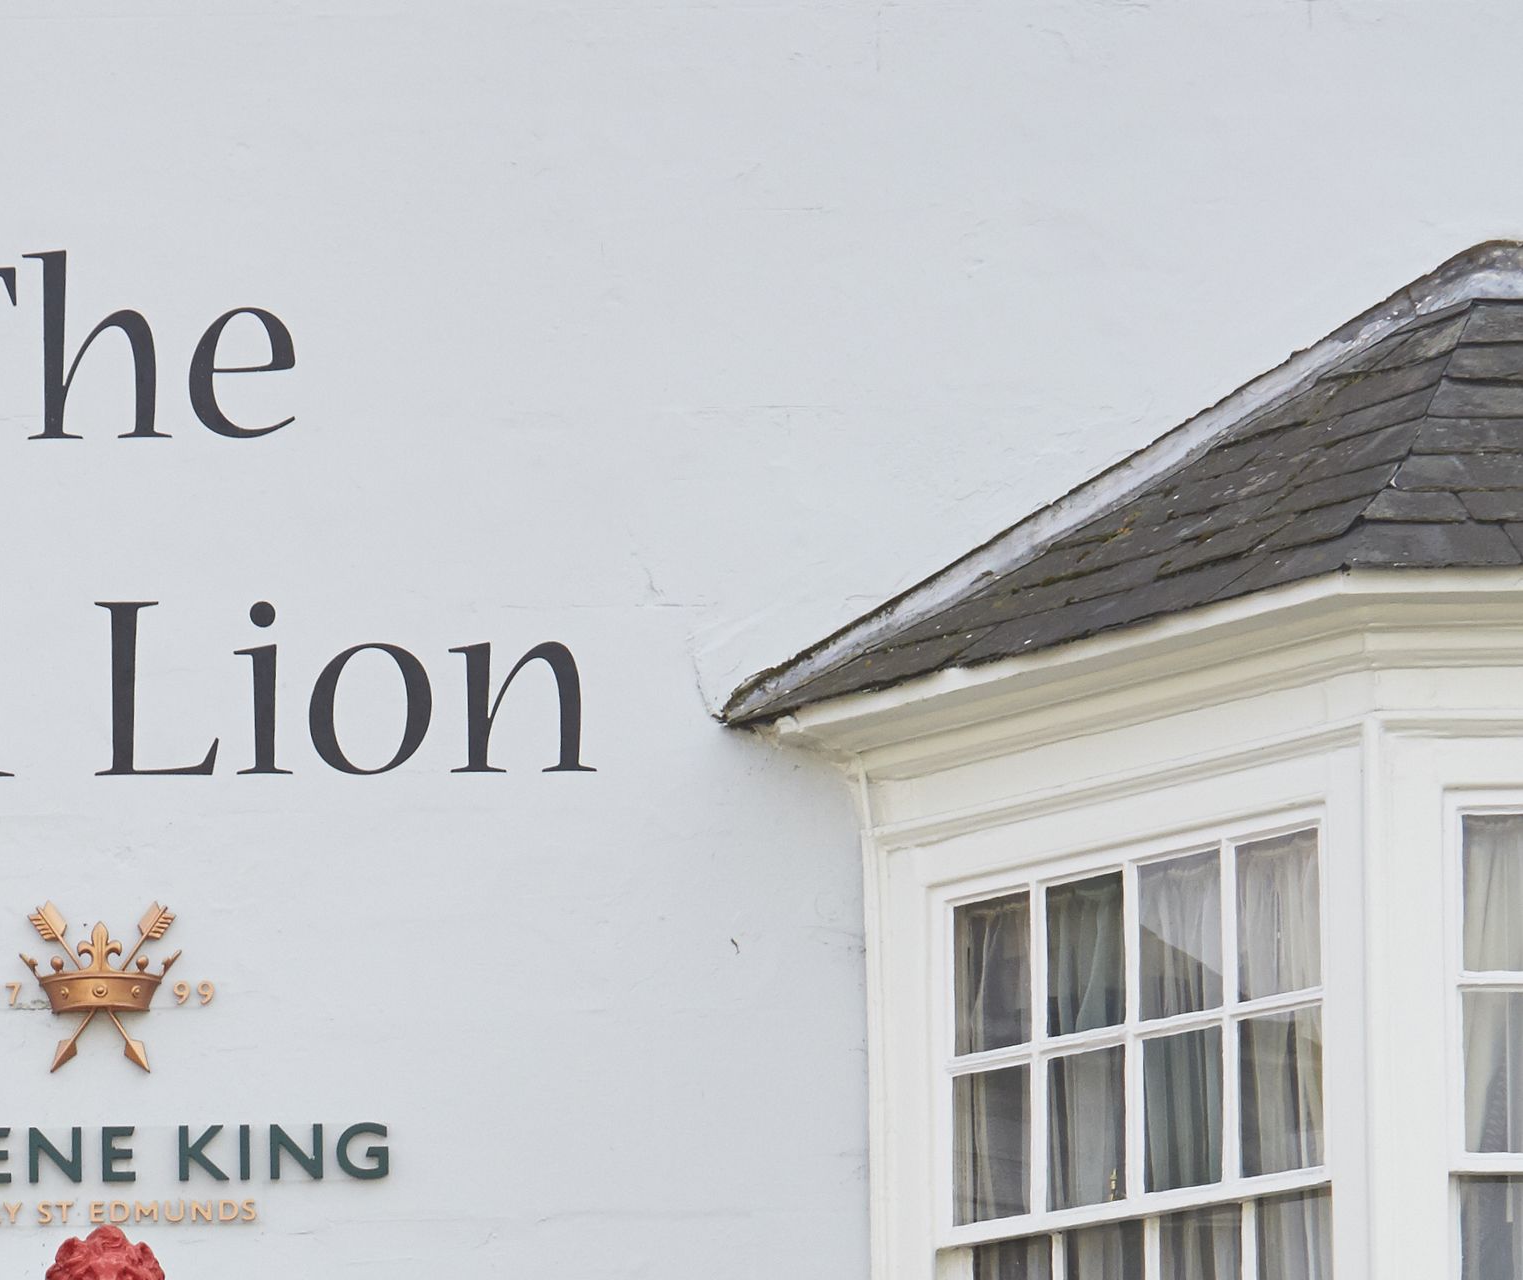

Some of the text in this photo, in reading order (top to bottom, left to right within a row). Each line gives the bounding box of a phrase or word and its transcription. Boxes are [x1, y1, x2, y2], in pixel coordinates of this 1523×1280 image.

[94, 601, 598, 776] Lion
[173, 980, 215, 1005] 99
[178, 1122, 390, 1181] KING
[38, 1202, 74, 1224] ST
[89, 1199, 257, 1223] EDMUNDS
